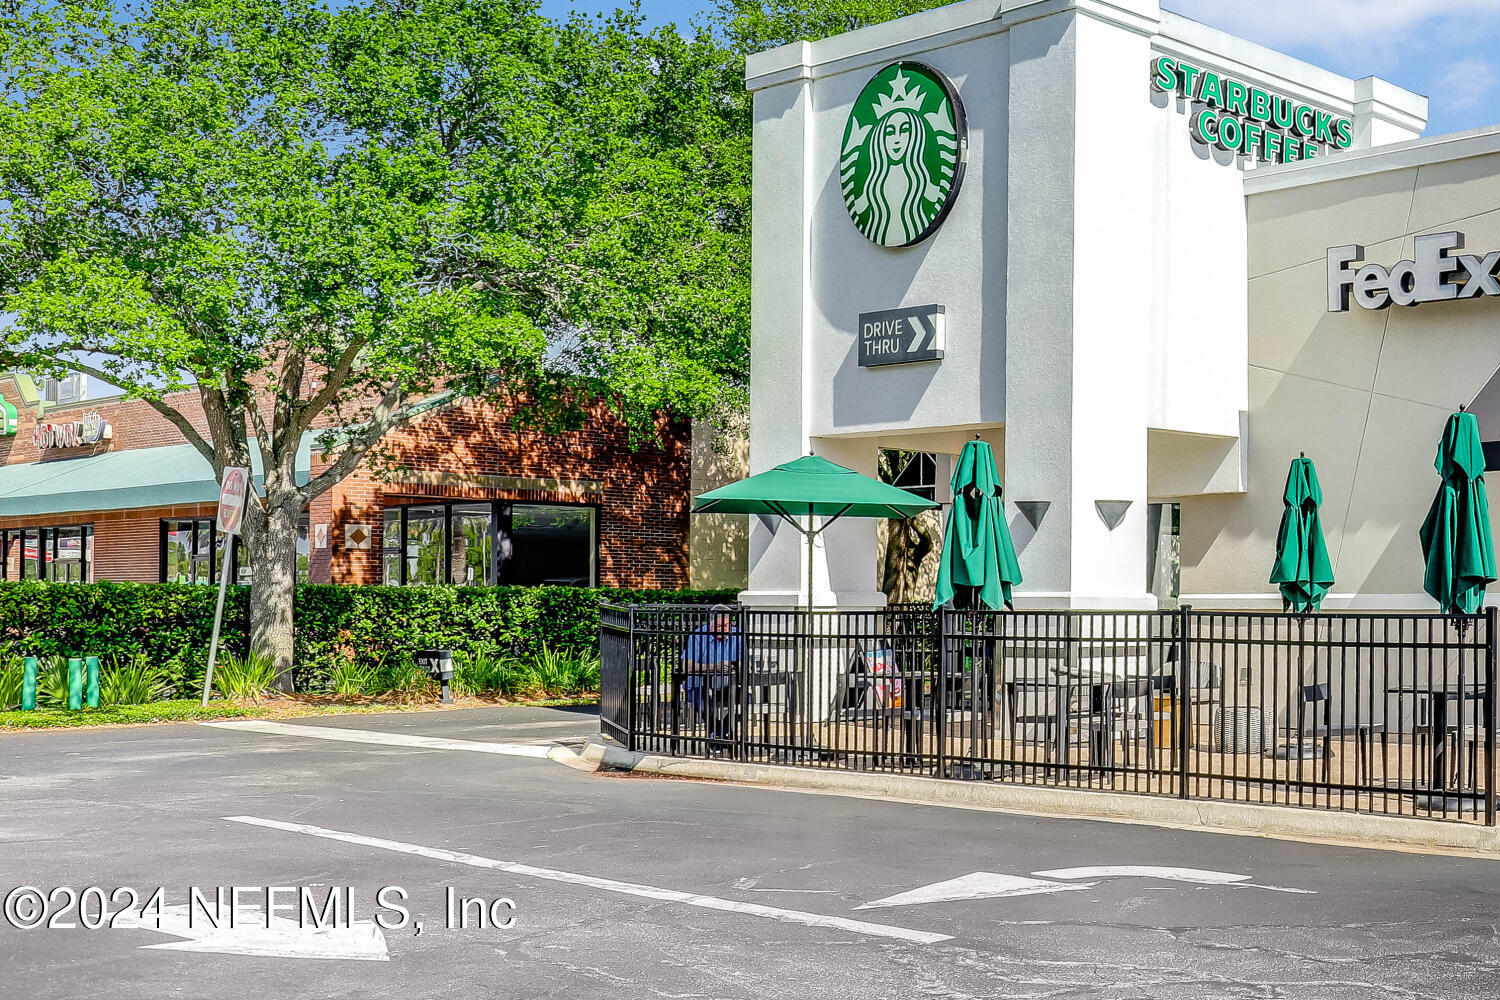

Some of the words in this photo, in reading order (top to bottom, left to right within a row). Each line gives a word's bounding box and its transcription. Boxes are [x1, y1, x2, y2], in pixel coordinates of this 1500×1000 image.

[1152, 56, 1353, 150] STARBUCKS
[1191, 109, 1319, 164] COFFEE
[864, 320, 903, 339] DRIVE
[864, 338, 900, 356] THRU
